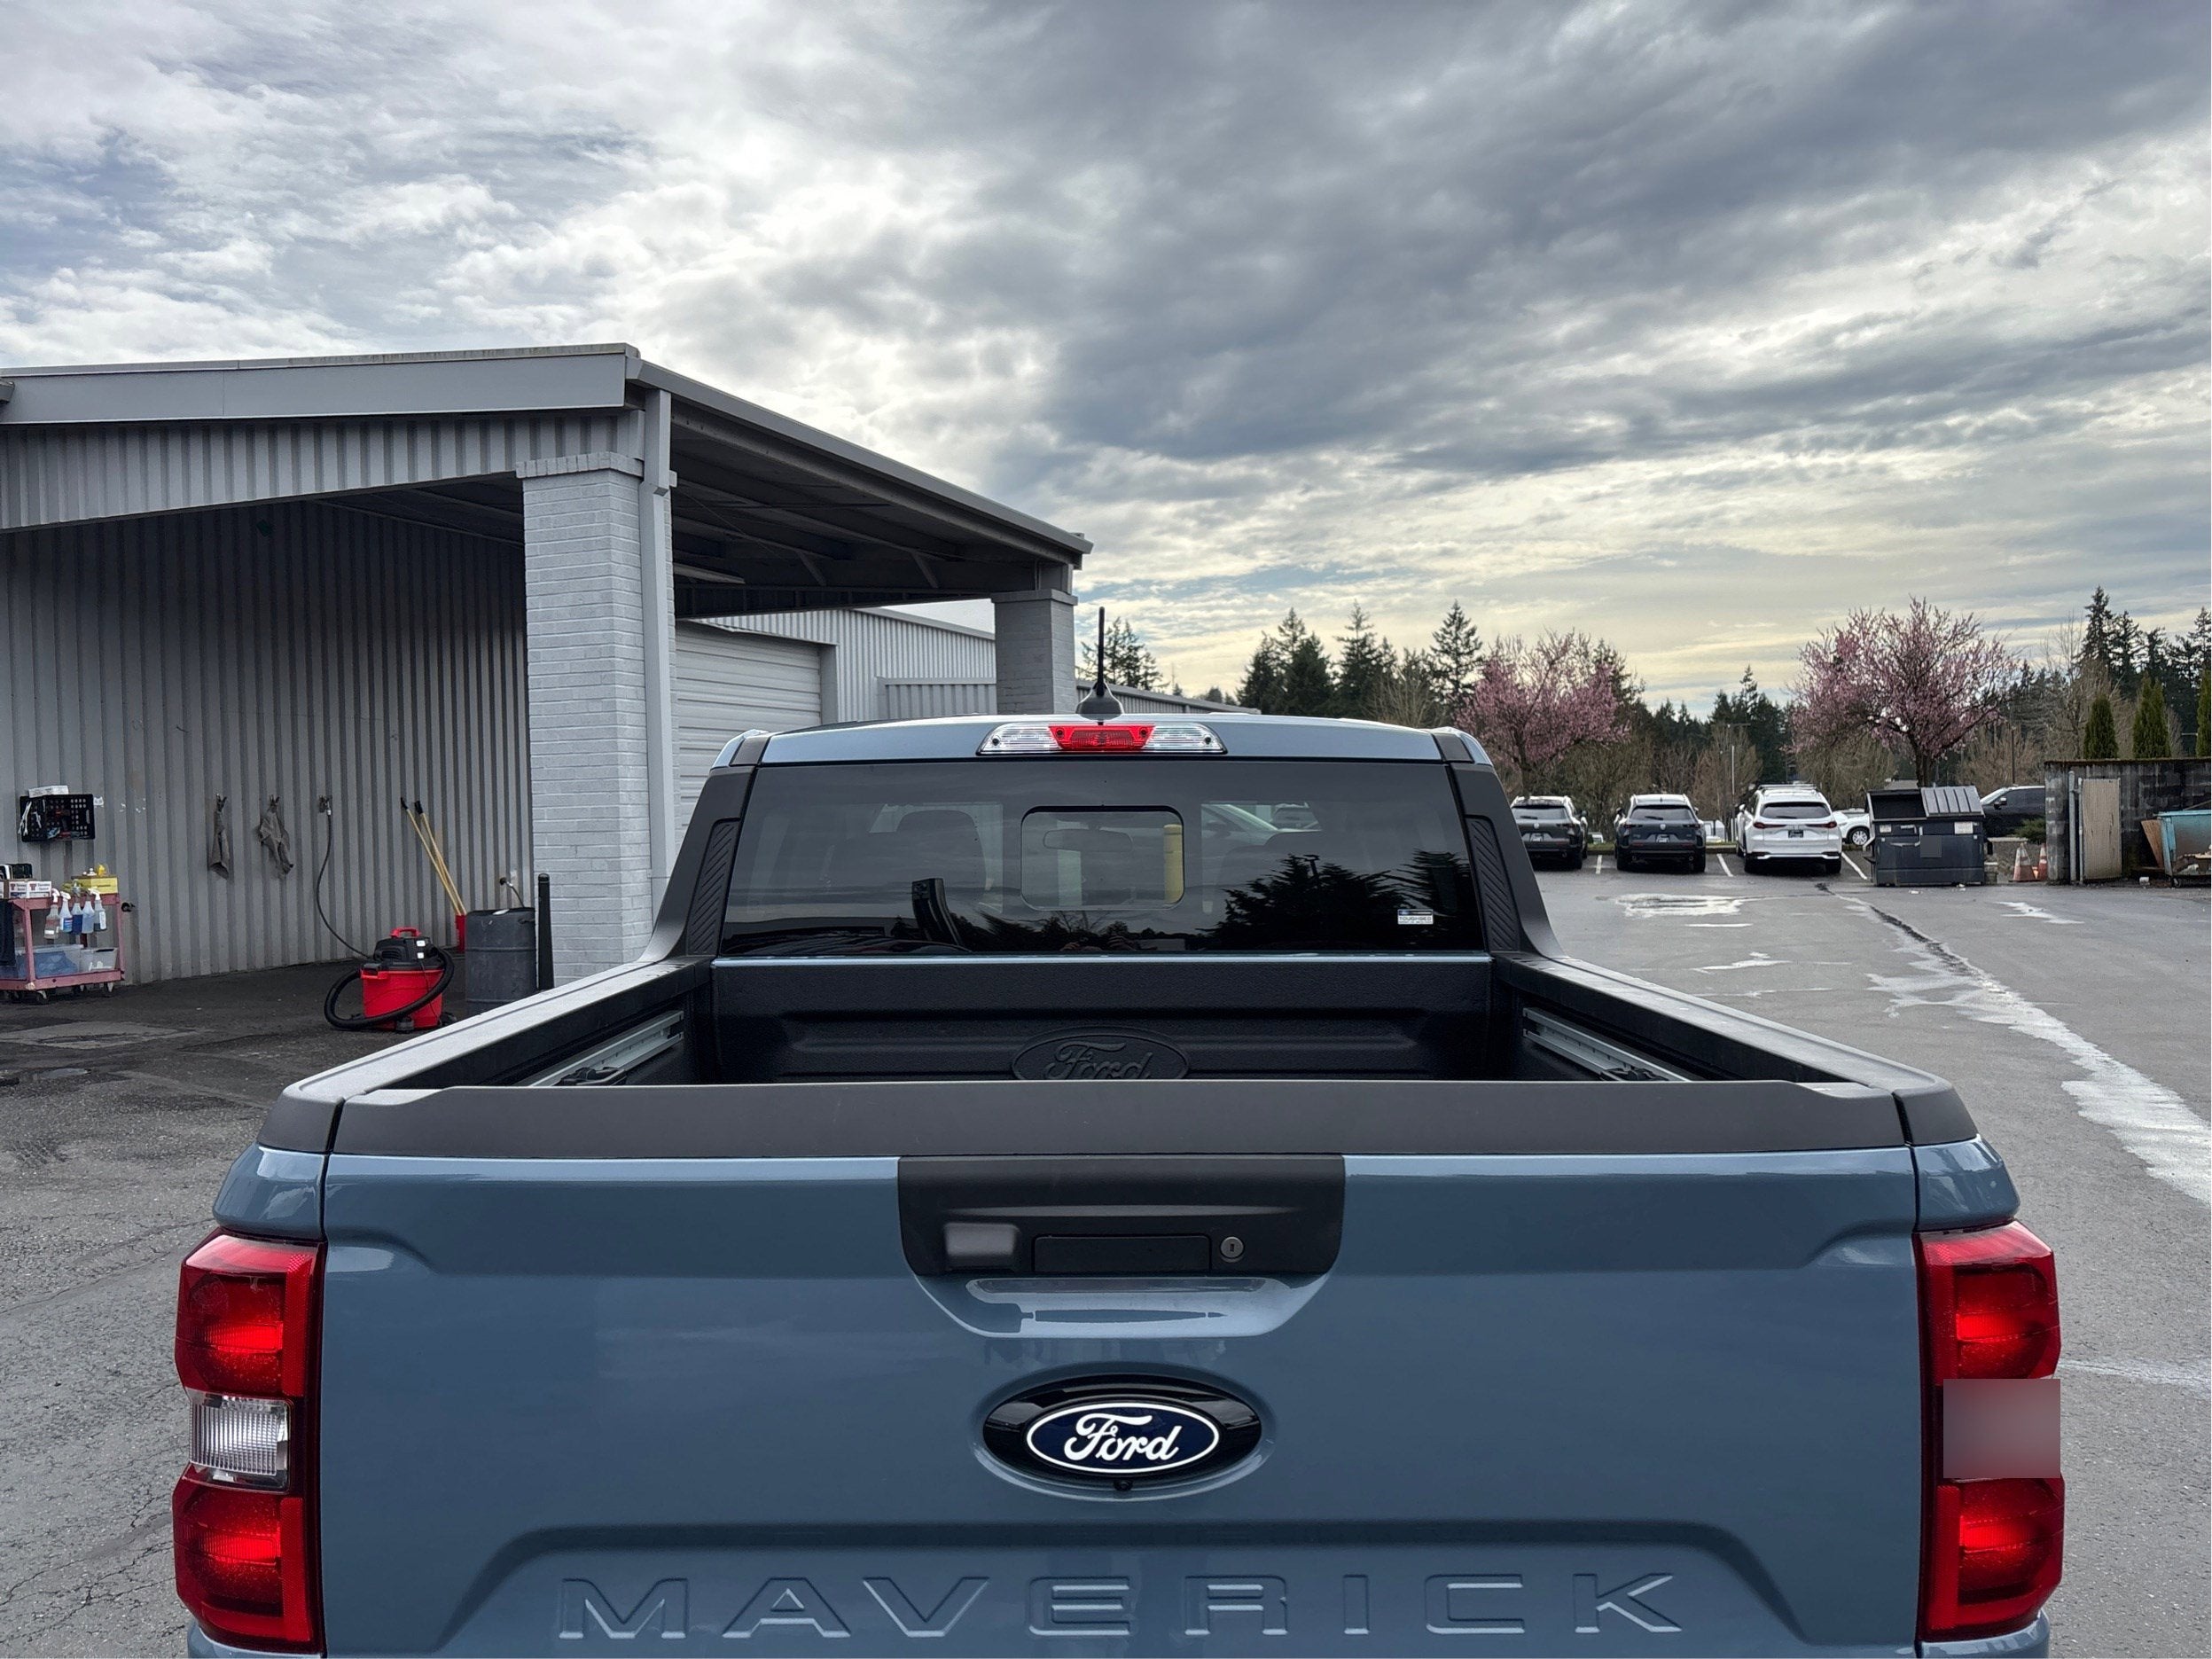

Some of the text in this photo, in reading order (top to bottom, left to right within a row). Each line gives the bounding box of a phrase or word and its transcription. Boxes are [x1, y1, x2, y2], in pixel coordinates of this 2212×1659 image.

[1043, 1041, 1153, 1080] Ford
[1064, 1412, 1182, 1461] Ford
[558, 1573, 1683, 1640] MAVERICK
